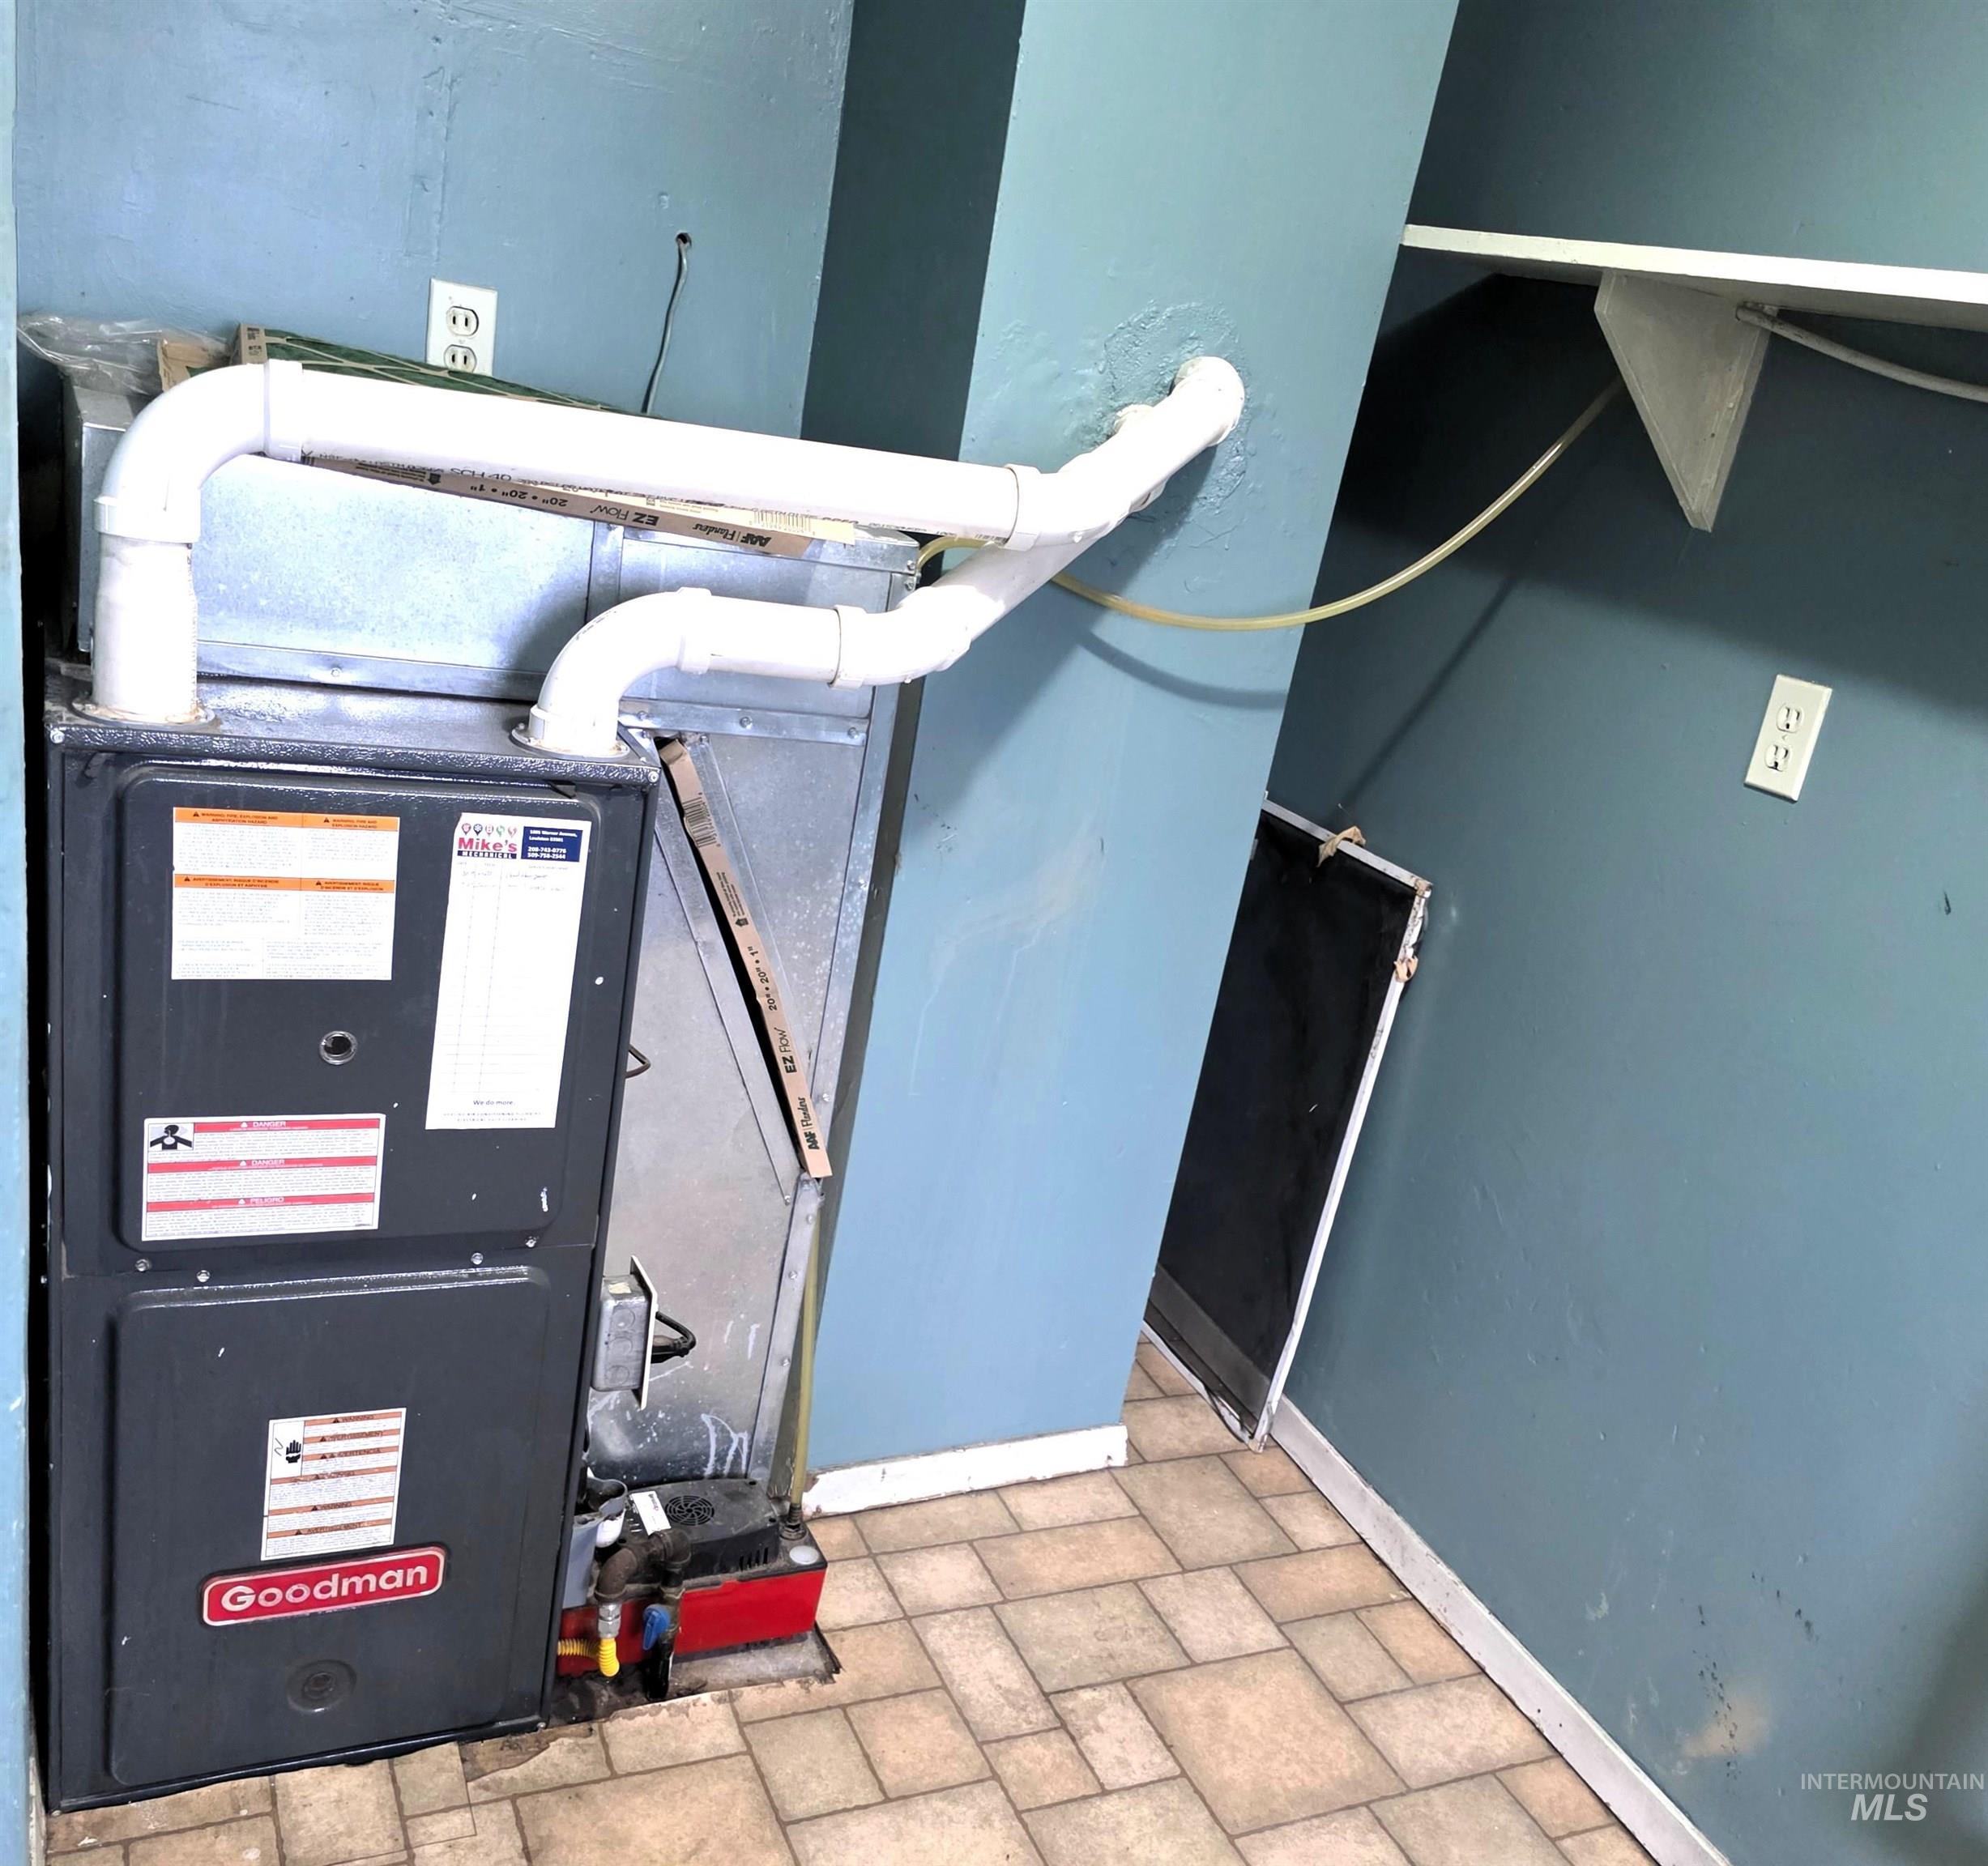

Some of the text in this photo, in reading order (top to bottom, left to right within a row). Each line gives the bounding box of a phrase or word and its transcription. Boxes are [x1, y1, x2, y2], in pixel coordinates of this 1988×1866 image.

[592, 505, 629, 521] Flow
[632, 512, 659, 526] EZ
[693, 523, 735, 543] Flanders
[458, 837, 518, 853] Mike's
[462, 850, 513, 859] MECHANICAL
[778, 1027, 797, 1074] EZ Flow
[252, 1120, 286, 1128] DANGER
[797, 1097, 820, 1151] AAF Flanders
[251, 1159, 285, 1167] DANGER
[220, 1565, 428, 1612] Goodman
